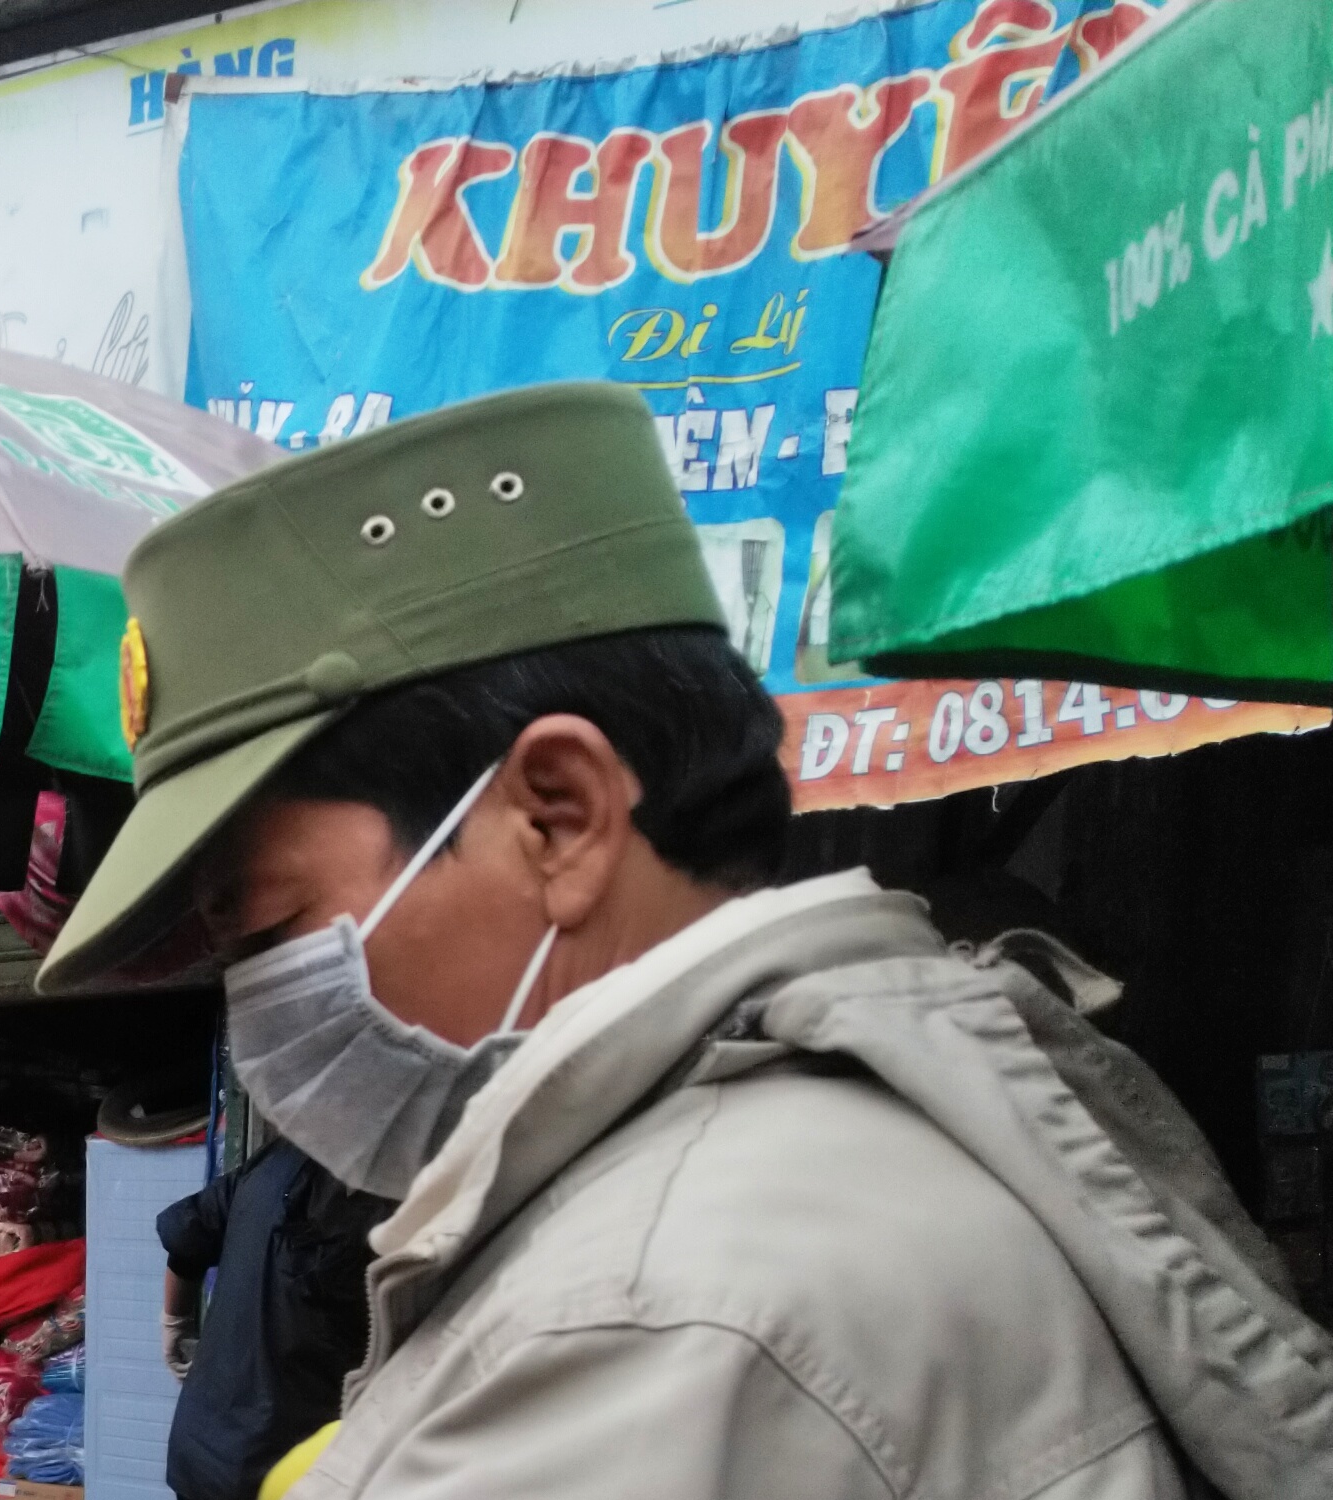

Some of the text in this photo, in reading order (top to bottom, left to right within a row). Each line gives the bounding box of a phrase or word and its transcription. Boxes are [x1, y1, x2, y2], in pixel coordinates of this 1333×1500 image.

[1106, 201, 1193, 337] 100%
[1201, 123, 1268, 261] CÀ
[799, 707, 910, 782] ĐT:
